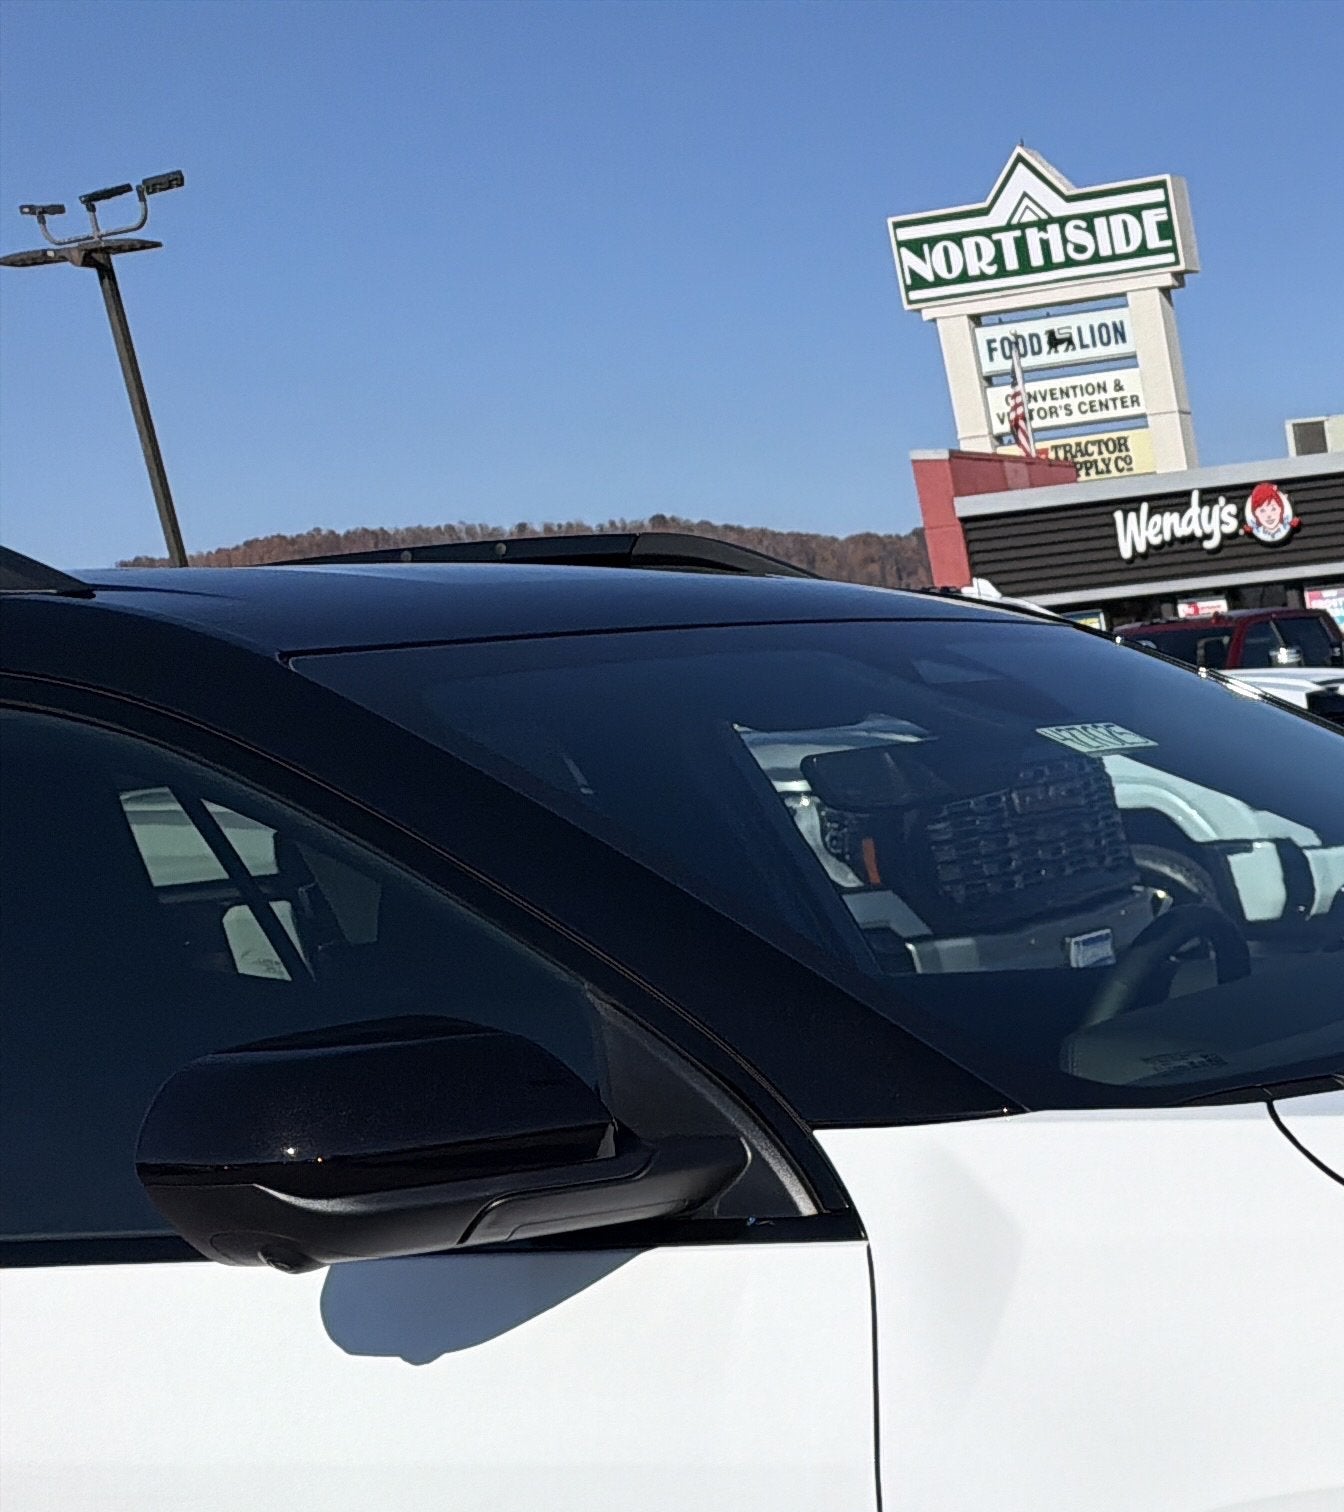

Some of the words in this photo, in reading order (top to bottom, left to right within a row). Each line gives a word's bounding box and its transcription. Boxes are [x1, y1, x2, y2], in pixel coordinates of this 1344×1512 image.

[900, 207, 1172, 286] NORTHSIDE
[986, 332, 1043, 363] FOOD
[1077, 319, 1127, 350] LION
[1113, 378, 1125, 393] &
[1077, 394, 1141, 415] CENTER
[1050, 435, 1130, 462] TRACTOR
[1113, 489, 1239, 559] Wendy's
